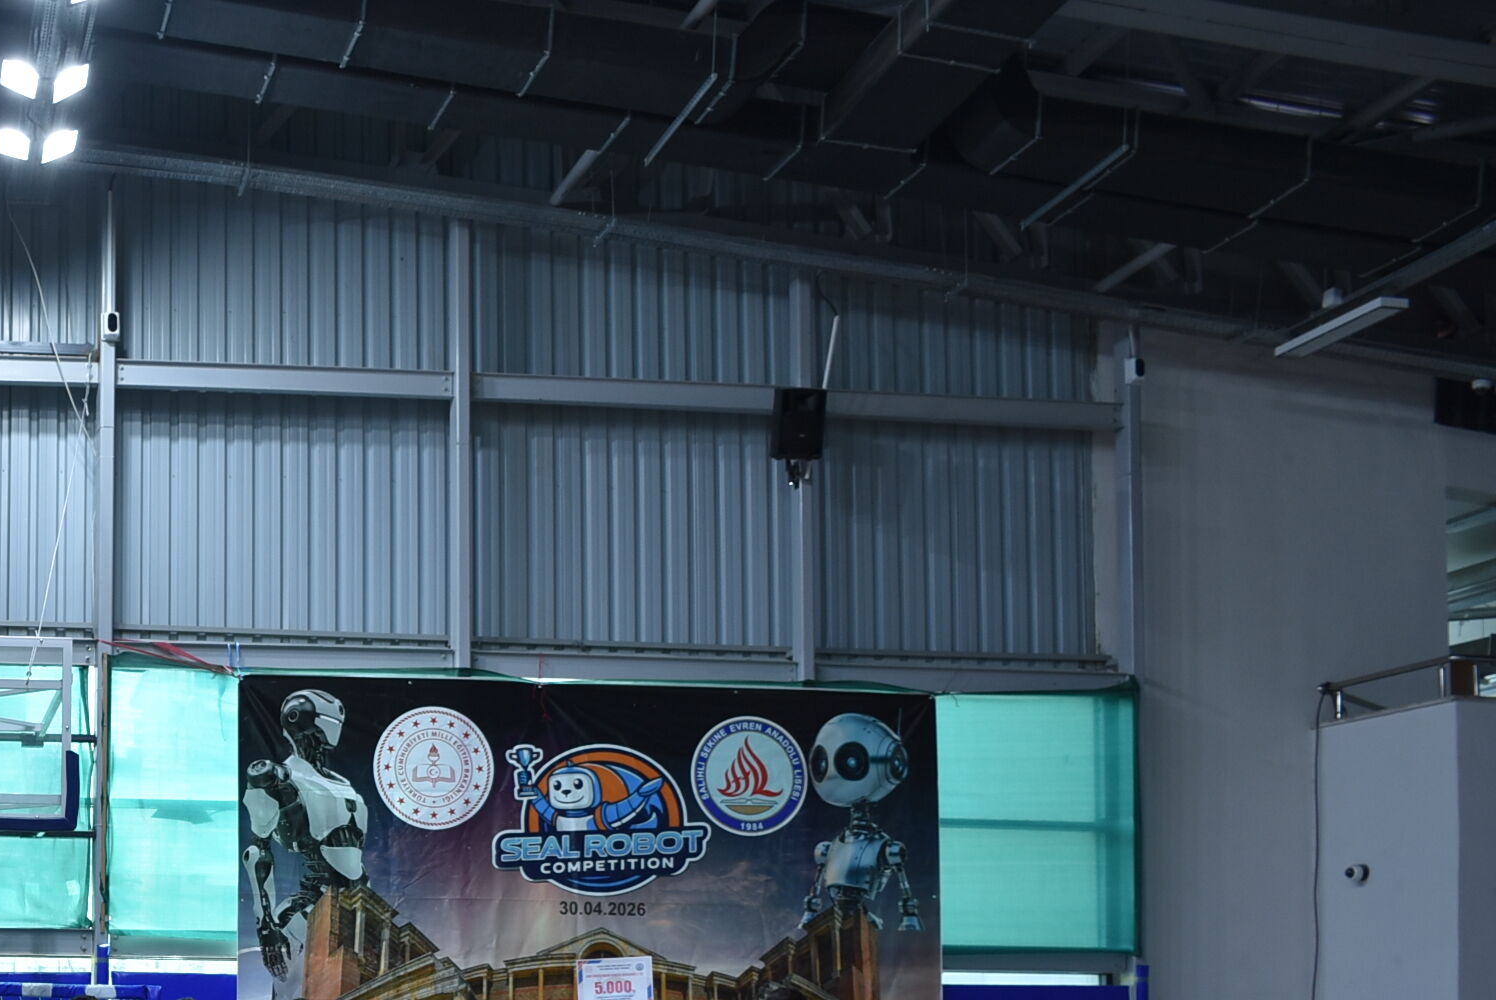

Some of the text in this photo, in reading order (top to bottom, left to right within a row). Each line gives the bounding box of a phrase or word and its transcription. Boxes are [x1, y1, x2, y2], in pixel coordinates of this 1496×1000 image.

[729, 722, 762, 733] EVREN
[765, 727, 800, 766] ANADOLU
[740, 822, 764, 831] 1984
[500, 829, 704, 862] SEAL ROBOT
[540, 857, 675, 874] COMPETITION
[559, 901, 646, 917] 30.04.2026
